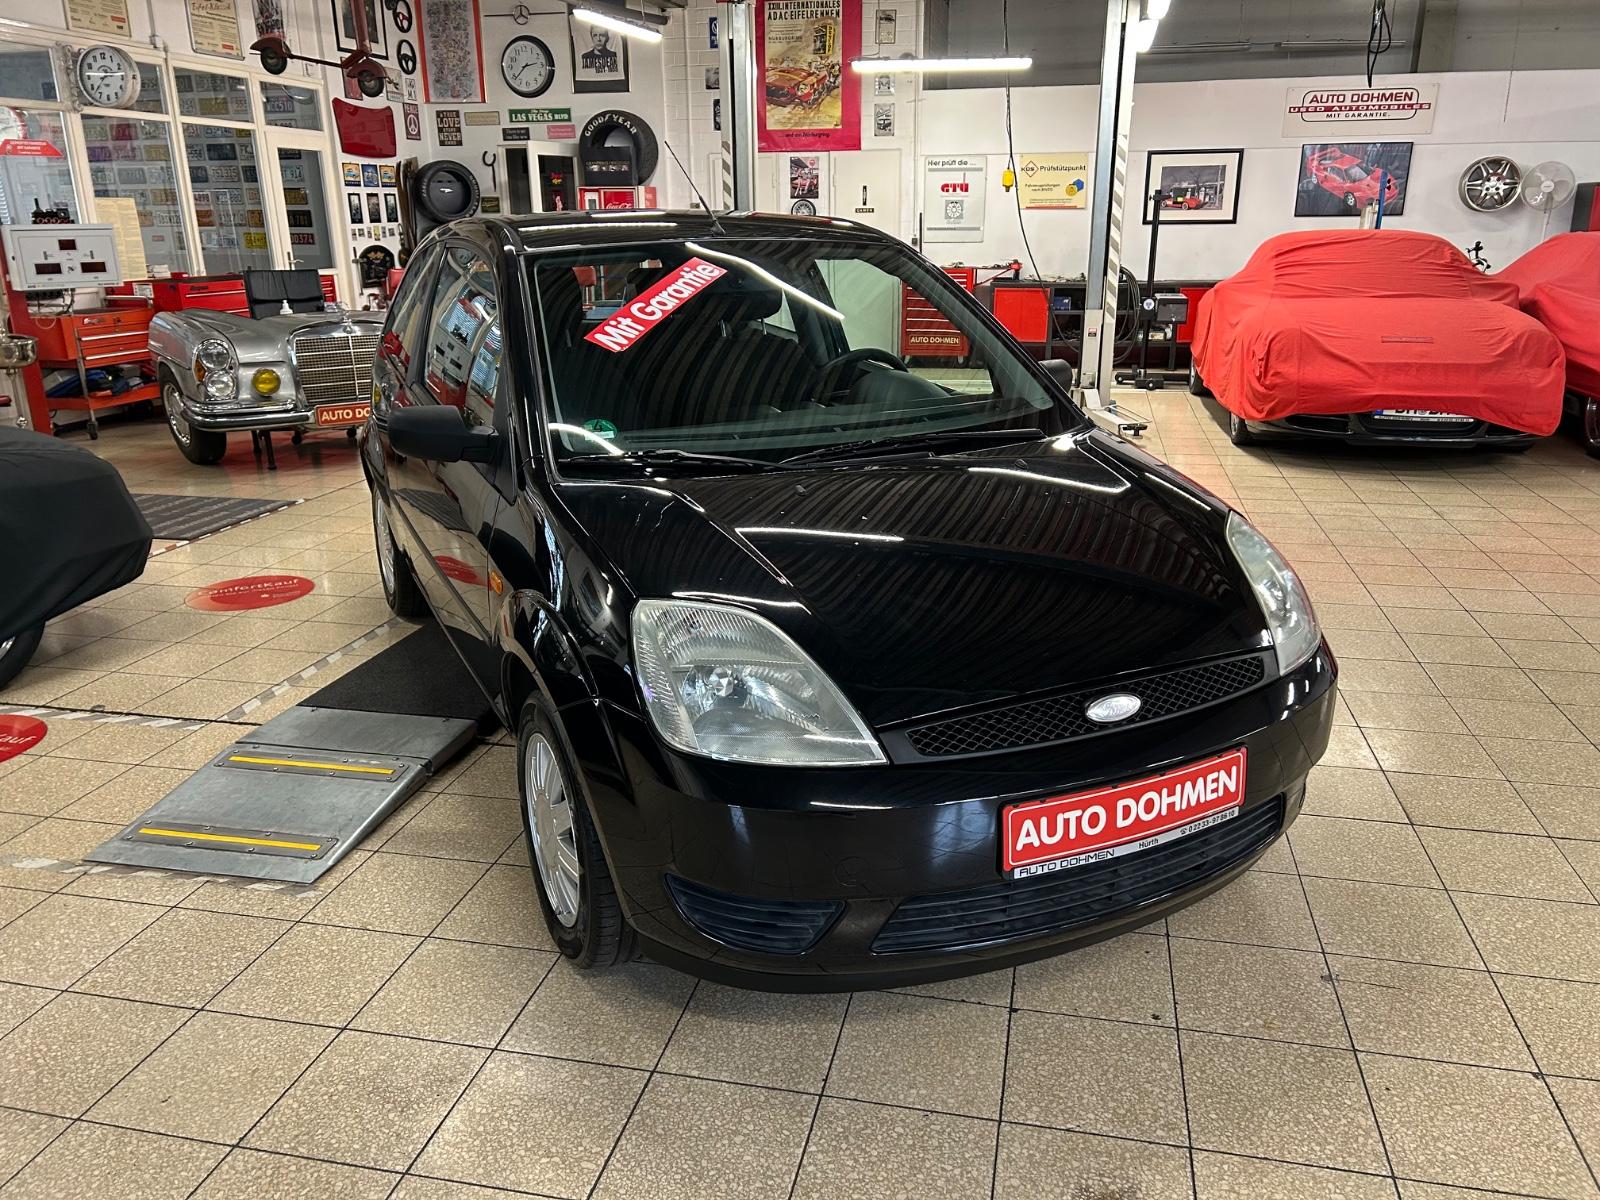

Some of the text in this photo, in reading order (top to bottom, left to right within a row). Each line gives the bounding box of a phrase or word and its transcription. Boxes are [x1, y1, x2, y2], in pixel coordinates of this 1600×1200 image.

[1309, 92, 1413, 104] AUTO DOHMEN
[438, 118, 460, 127] LOVE
[512, 113, 526, 121] LAS
[528, 112, 553, 121] VEGAS
[584, 113, 637, 137] GOODYEAR
[594, 265, 720, 351] Mit Garantie
[322, 410, 353, 421] AUTO
[1016, 765, 1238, 851] AUTO DOHMEN
[1020, 862, 1057, 877] AUTO
[1060, 849, 1115, 869] DOHMEN
[1139, 838, 1159, 849] Hürth
